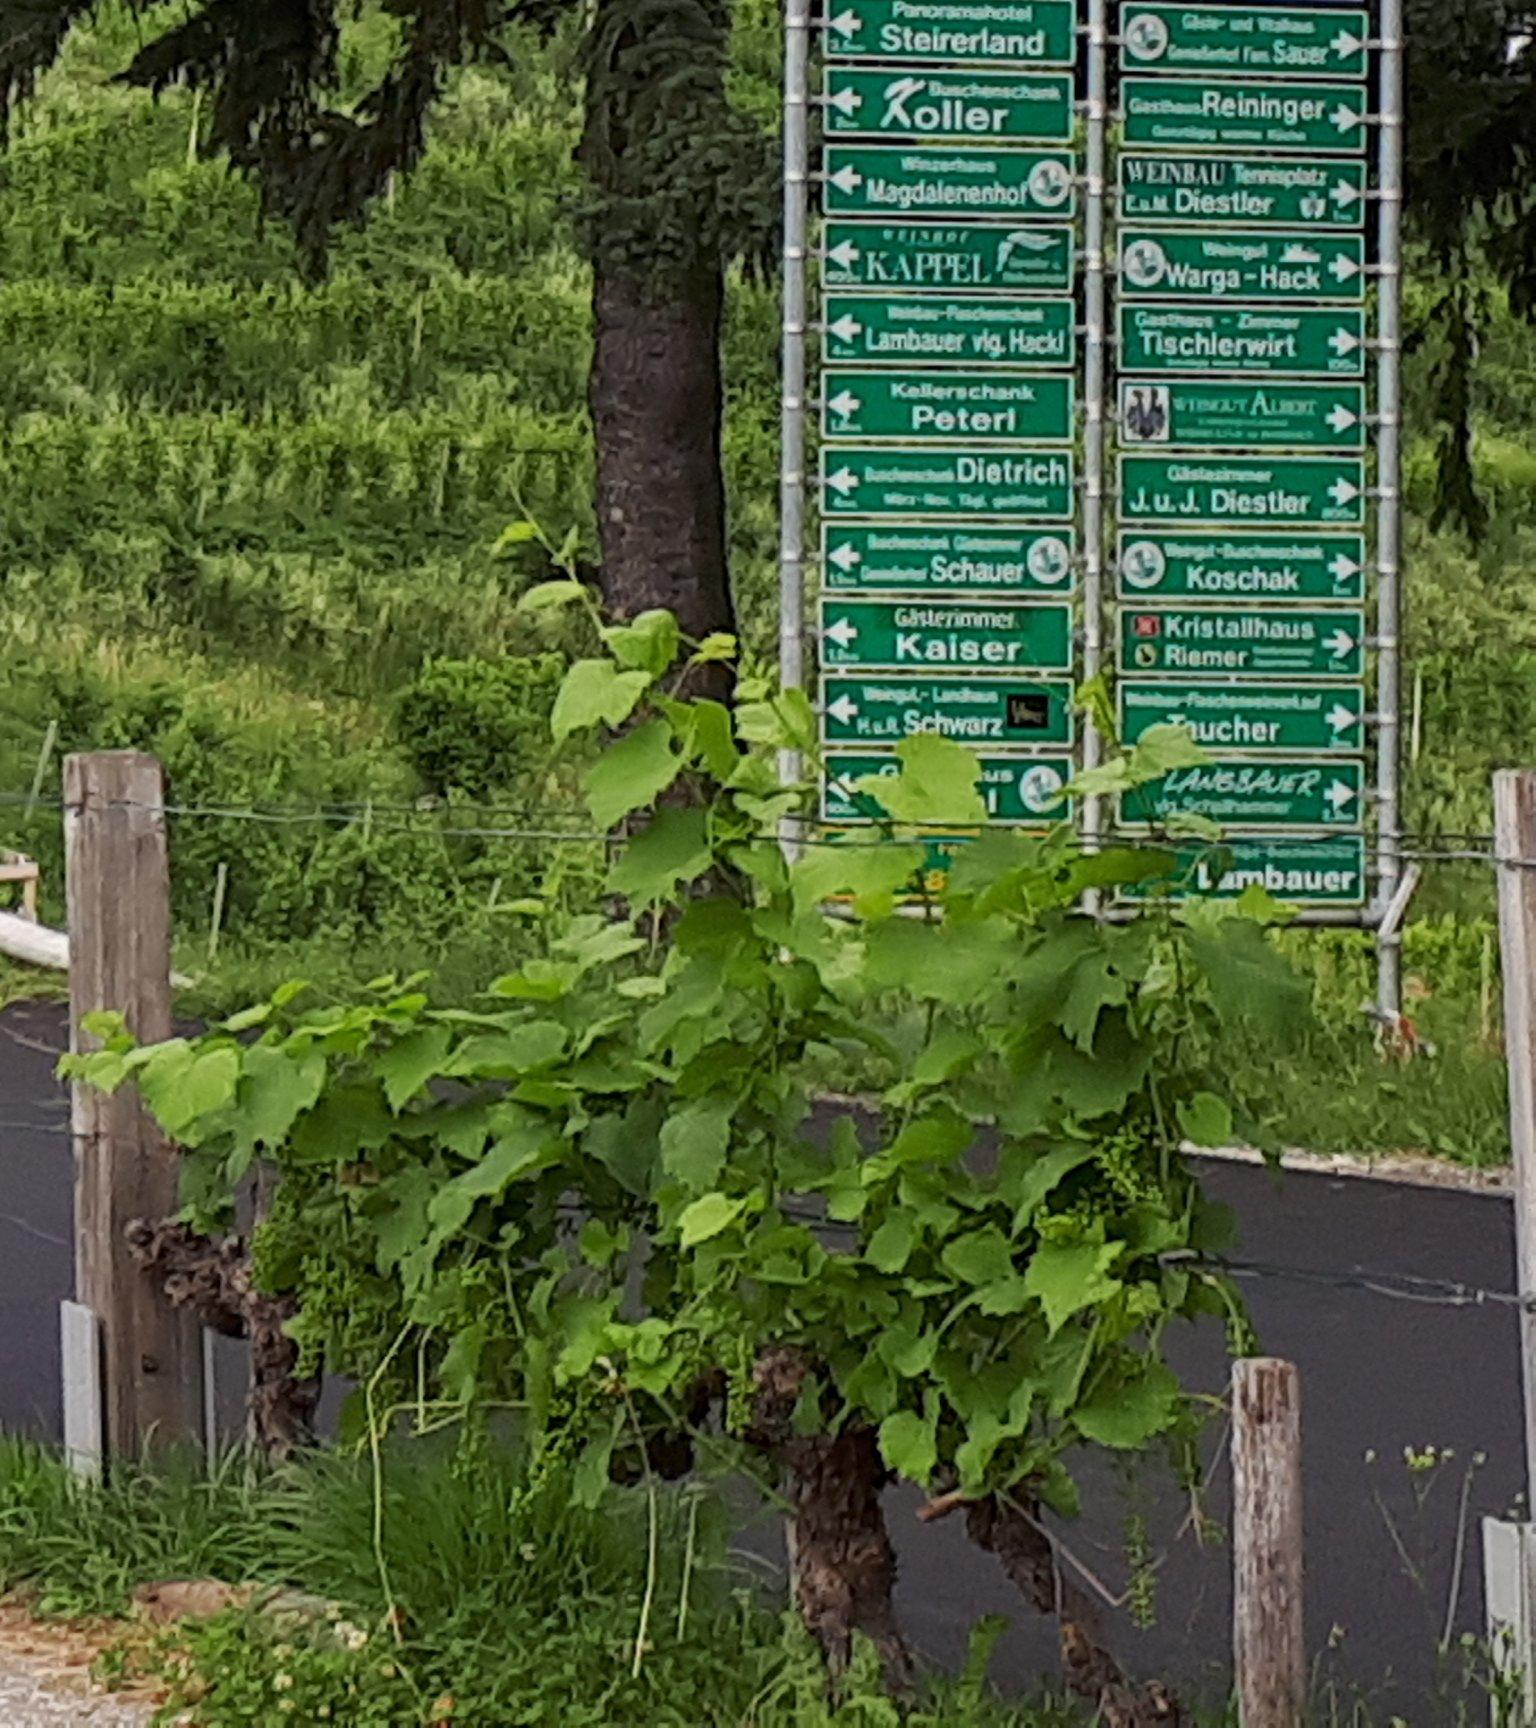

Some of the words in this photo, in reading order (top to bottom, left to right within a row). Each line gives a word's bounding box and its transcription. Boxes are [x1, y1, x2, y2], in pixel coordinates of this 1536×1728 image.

[892, 0, 1033, 23] Panoramahotel
[880, 24, 1045, 57] Steirerland
[1272, 39, 1329, 65] Sauer
[879, 77, 1009, 132] Koller
[1203, 89, 1326, 124] Reininger
[1126, 161, 1226, 186] WEINBAU
[866, 178, 1029, 208] Magdalenenhof
[1175, 187, 1275, 215] Diestler
[866, 250, 992, 283] KAPPEL
[865, 326, 965, 353] Lambauer
[1009, 328, 1065, 355] Hackl
[1138, 330, 1298, 358] Tischlerwirt
[890, 382, 1037, 402] Kellerschank
[956, 457, 1066, 486] Dietrich
[1211, 488, 1311, 515] Diestler
[930, 554, 1025, 584] Schauer
[1186, 565, 1300, 591] Koschak
[1164, 616, 1316, 640] Kristallhaus
[895, 632, 1023, 662] Kaiser
[1164, 644, 1249, 667] Riemer
[903, 709, 1004, 737] Schwarz
[1162, 767, 1322, 798] LANGBAUER
